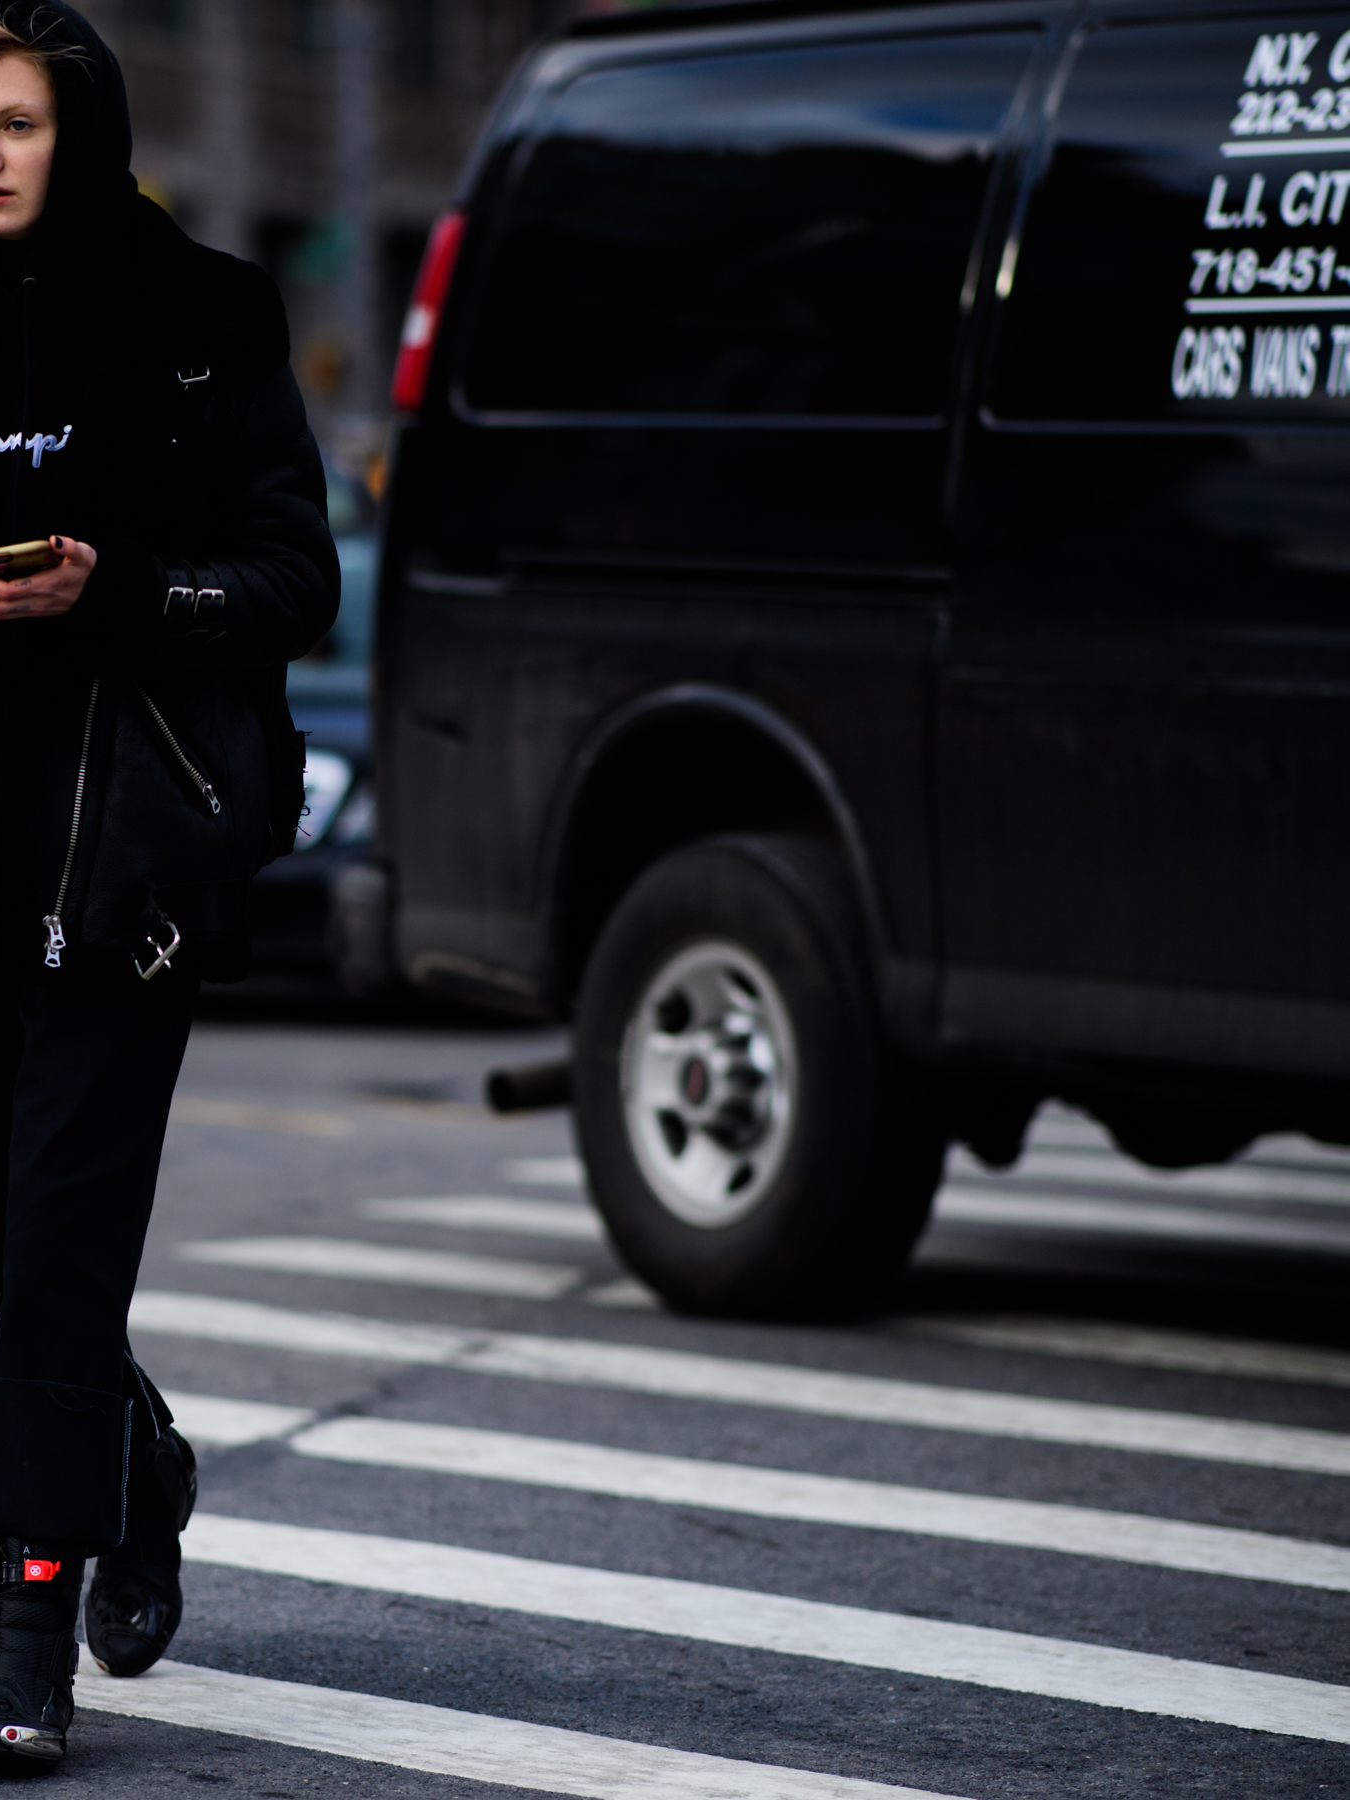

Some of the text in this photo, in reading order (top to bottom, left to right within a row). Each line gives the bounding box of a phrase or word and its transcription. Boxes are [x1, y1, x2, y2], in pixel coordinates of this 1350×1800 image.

[1243, 31, 1320, 87] N.Y.
[1203, 173, 1267, 229] L.I.
[1189, 245, 1350, 294] 718-451-
[1171, 325, 1245, 399] CARS
[1249, 324, 1321, 399] VANS
